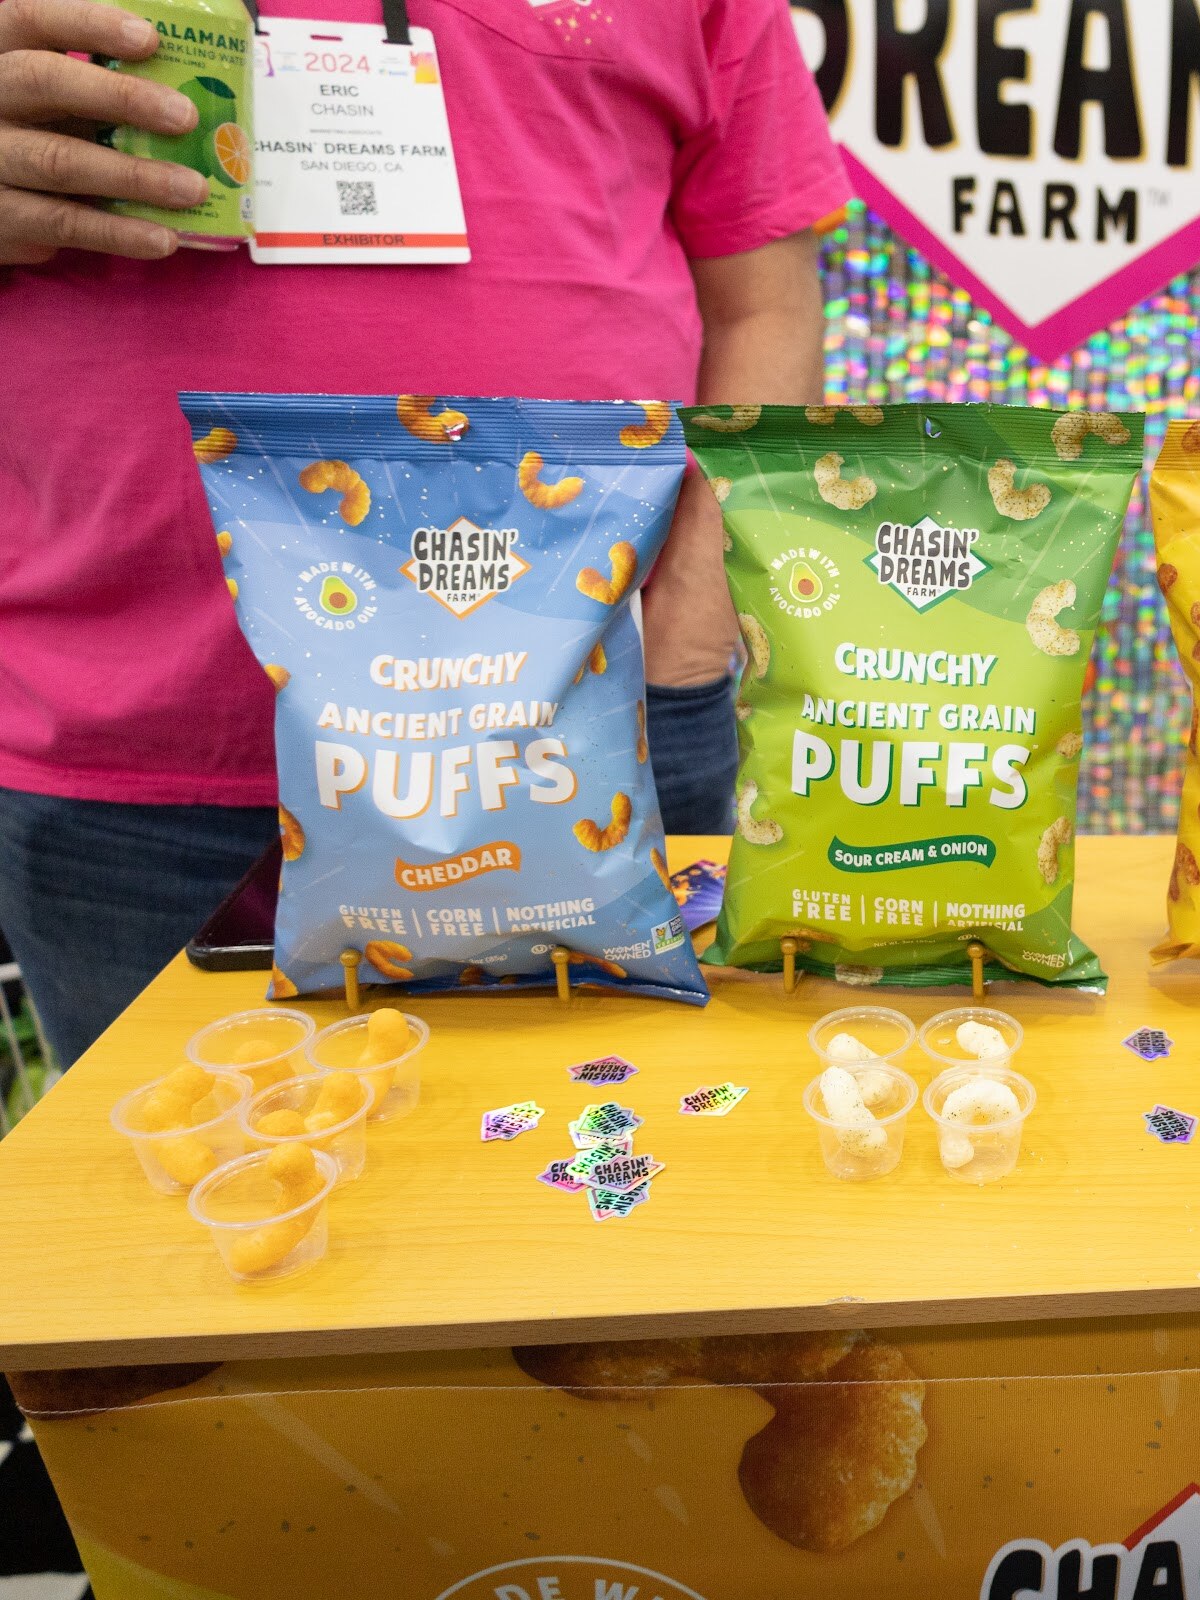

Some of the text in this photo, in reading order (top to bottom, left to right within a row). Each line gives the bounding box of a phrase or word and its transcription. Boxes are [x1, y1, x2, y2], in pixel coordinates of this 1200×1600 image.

[158, 40, 216, 60] ARKLING
[304, 52, 371, 74] 2024
[320, 84, 360, 97] ERIC
[311, 103, 375, 116] CHASIN
[324, 143, 396, 156] DREAMS
[400, 145, 447, 157] FARM
[301, 160, 328, 171] SAN
[385, 162, 404, 172] CA
[951, 176, 1139, 244] FARM
[322, 233, 405, 246] EXHIBITOR
[413, 530, 517, 562] CHASIN'
[877, 524, 979, 559] CHASIN'
[770, 547, 840, 578] MADE WITH
[298, 561, 377, 591] MADE WITH
[418, 563, 510, 591] DREAMS
[880, 560, 970, 588] DREAMS
[446, 592, 477, 603] FARM
[906, 587, 937, 597] FARM
[769, 587, 840, 619] AVOCADO OIL
[293, 596, 378, 631] AVOCADO OIL
[370, 651, 528, 691] CRUNCHY
[834, 642, 998, 687] CRUNCHY
[317, 701, 558, 740] ANCIENT GRAIN
[801, 693, 1036, 735] ANCIENT GRAIN
[315, 738, 579, 819] PUFFS
[791, 729, 1031, 810] PUFFS
[834, 841, 988, 867] SOUR CREAM & ONION
[401, 847, 513, 887] CHEDDAR
[792, 889, 851, 905] GLUTEN
[873, 897, 923, 914] CORN
[339, 904, 402, 919] GLUTEN
[426, 907, 482, 923] CORN
[506, 898, 595, 922] NOTHING
[792, 901, 852, 922] FREE
[874, 910, 924, 927] FREE
[946, 901, 1026, 919] NOTHING
[341, 915, 407, 935] FREE
[430, 922, 485, 936] FREE
[604, 949, 652, 960] OWNED
[582, 1064, 628, 1072] DREAMS
[692, 1093, 737, 1112] DREAMS
[594, 1156, 649, 1176] CHASIN'
[598, 1168, 649, 1185] DREAMS
[596, 1190, 619, 1210] AMS
[612, 1182, 647, 1214] ASIN'
